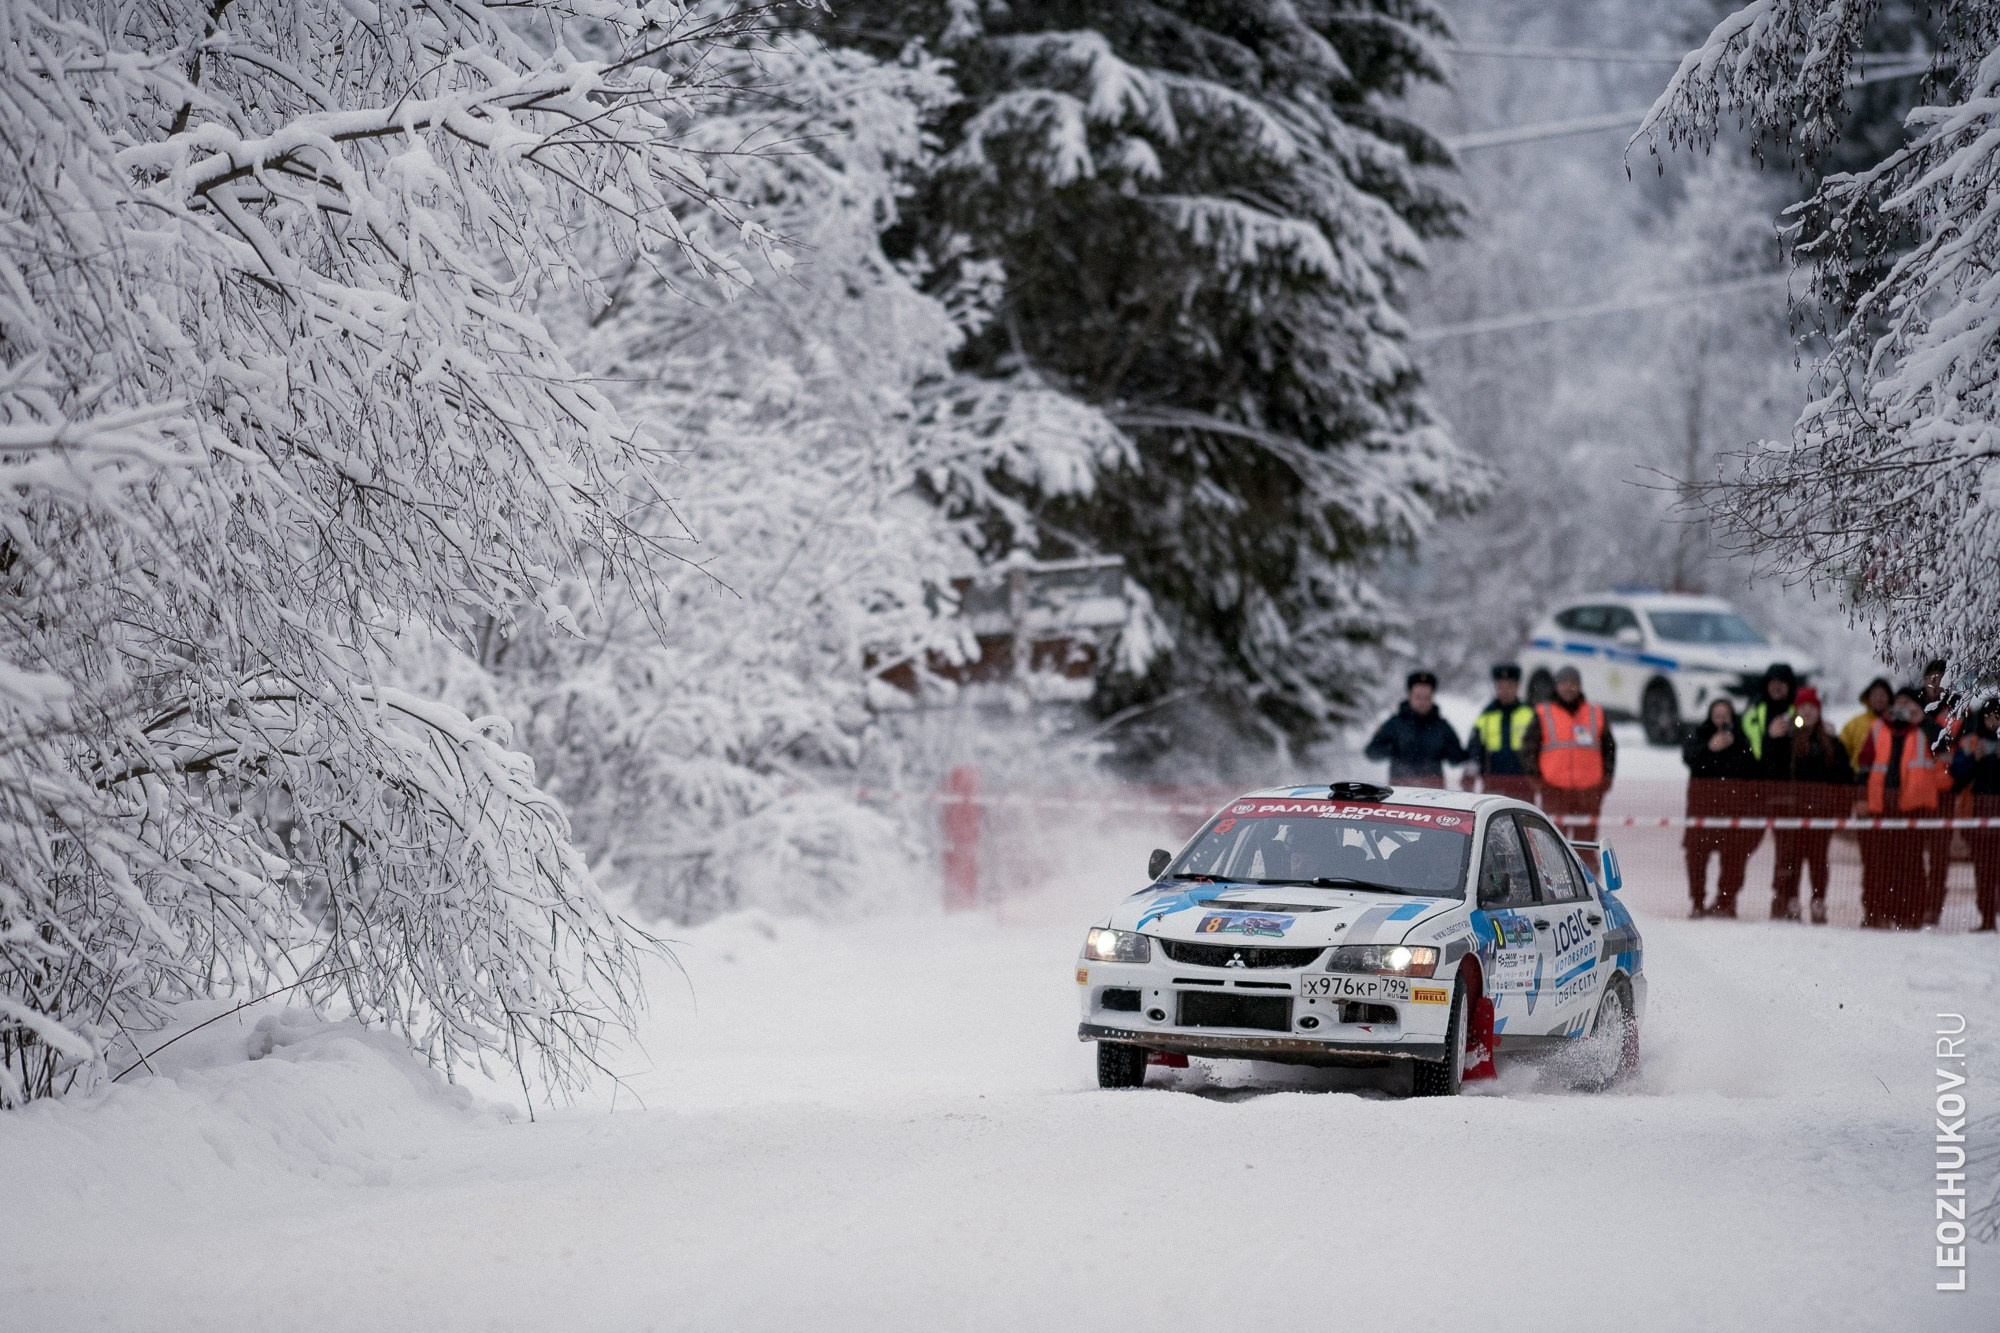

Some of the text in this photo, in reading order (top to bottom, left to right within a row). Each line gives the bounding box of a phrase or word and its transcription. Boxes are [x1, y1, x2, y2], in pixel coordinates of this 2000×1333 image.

[1258, 804, 1335, 813] РАЛЛИ
[1342, 806, 1432, 822] РОССИИ
[1213, 818, 1237, 834] 8
[1205, 917, 1223, 933] 8
[1493, 920, 1504, 946] 8
[1552, 907, 1592, 958] LOGIC
[1554, 940, 1597, 974] MOTORSPORT
[1382, 978, 1407, 993] 799
[1555, 982, 1577, 1007] LOGIC
[1578, 971, 1598, 992] CITY
[1414, 990, 1447, 1002] PIRELLI
